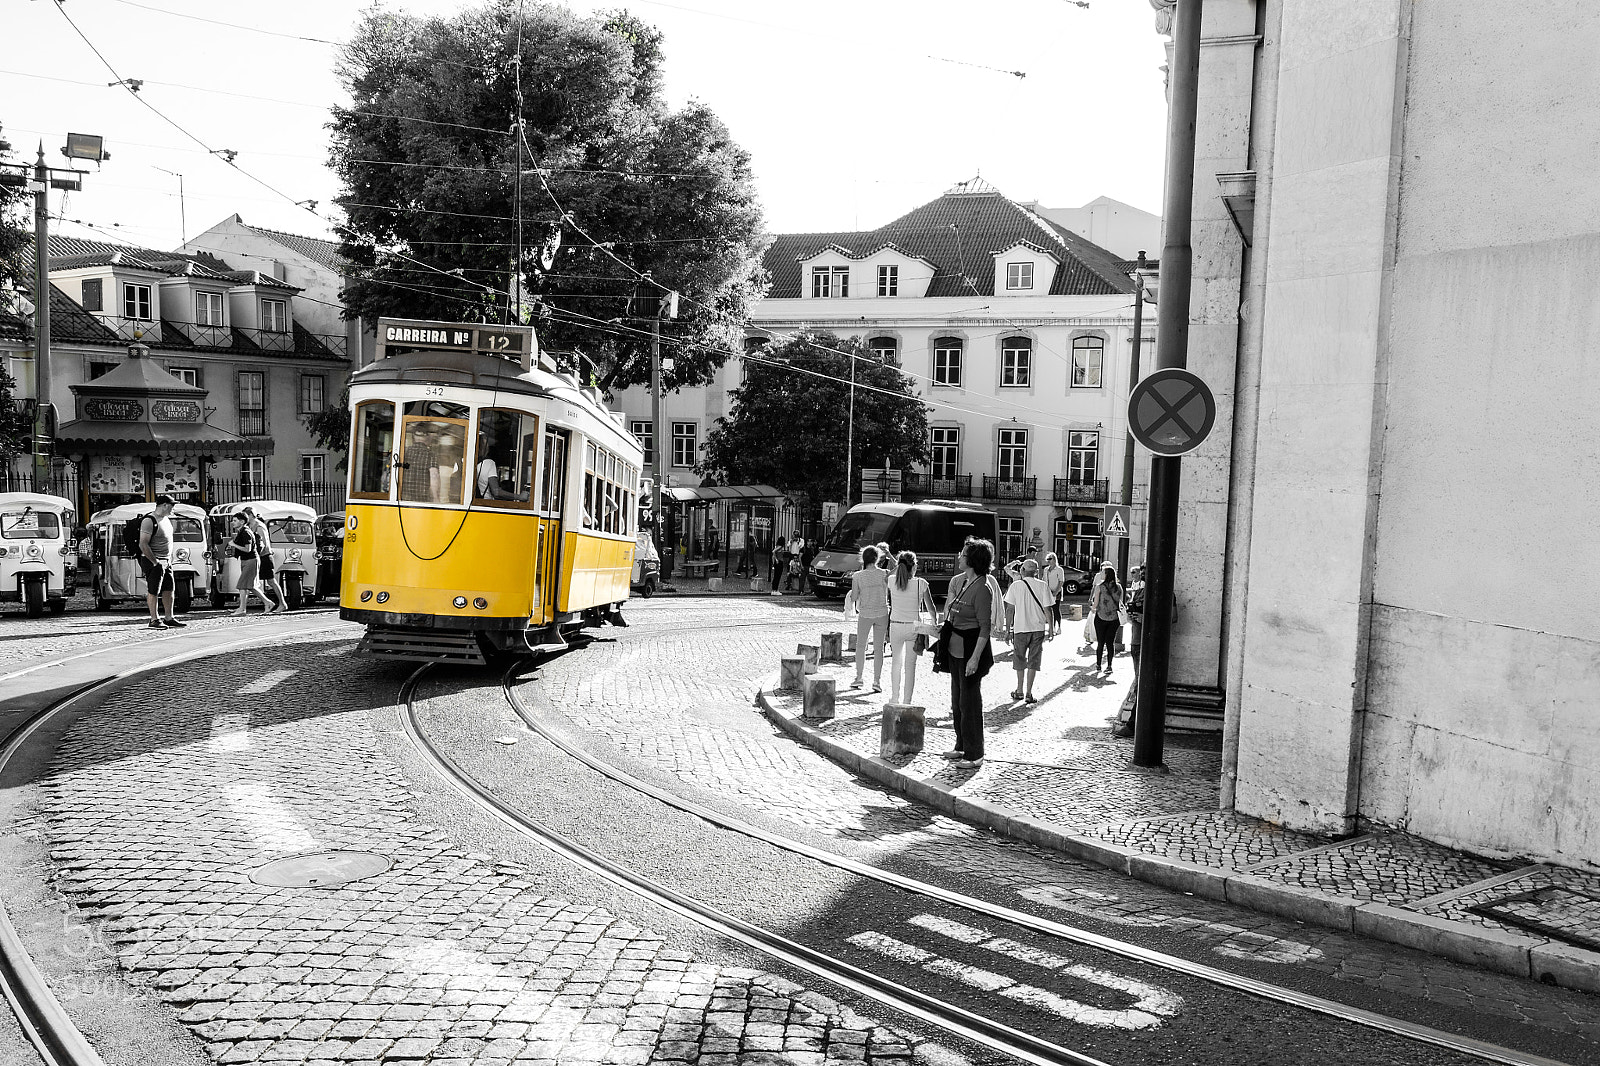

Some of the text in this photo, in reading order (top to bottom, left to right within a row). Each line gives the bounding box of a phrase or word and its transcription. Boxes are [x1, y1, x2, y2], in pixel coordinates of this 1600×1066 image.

[386, 327, 448, 344] CARREIRA
[488, 335, 510, 350] 12
[425, 387, 444, 396] 542
